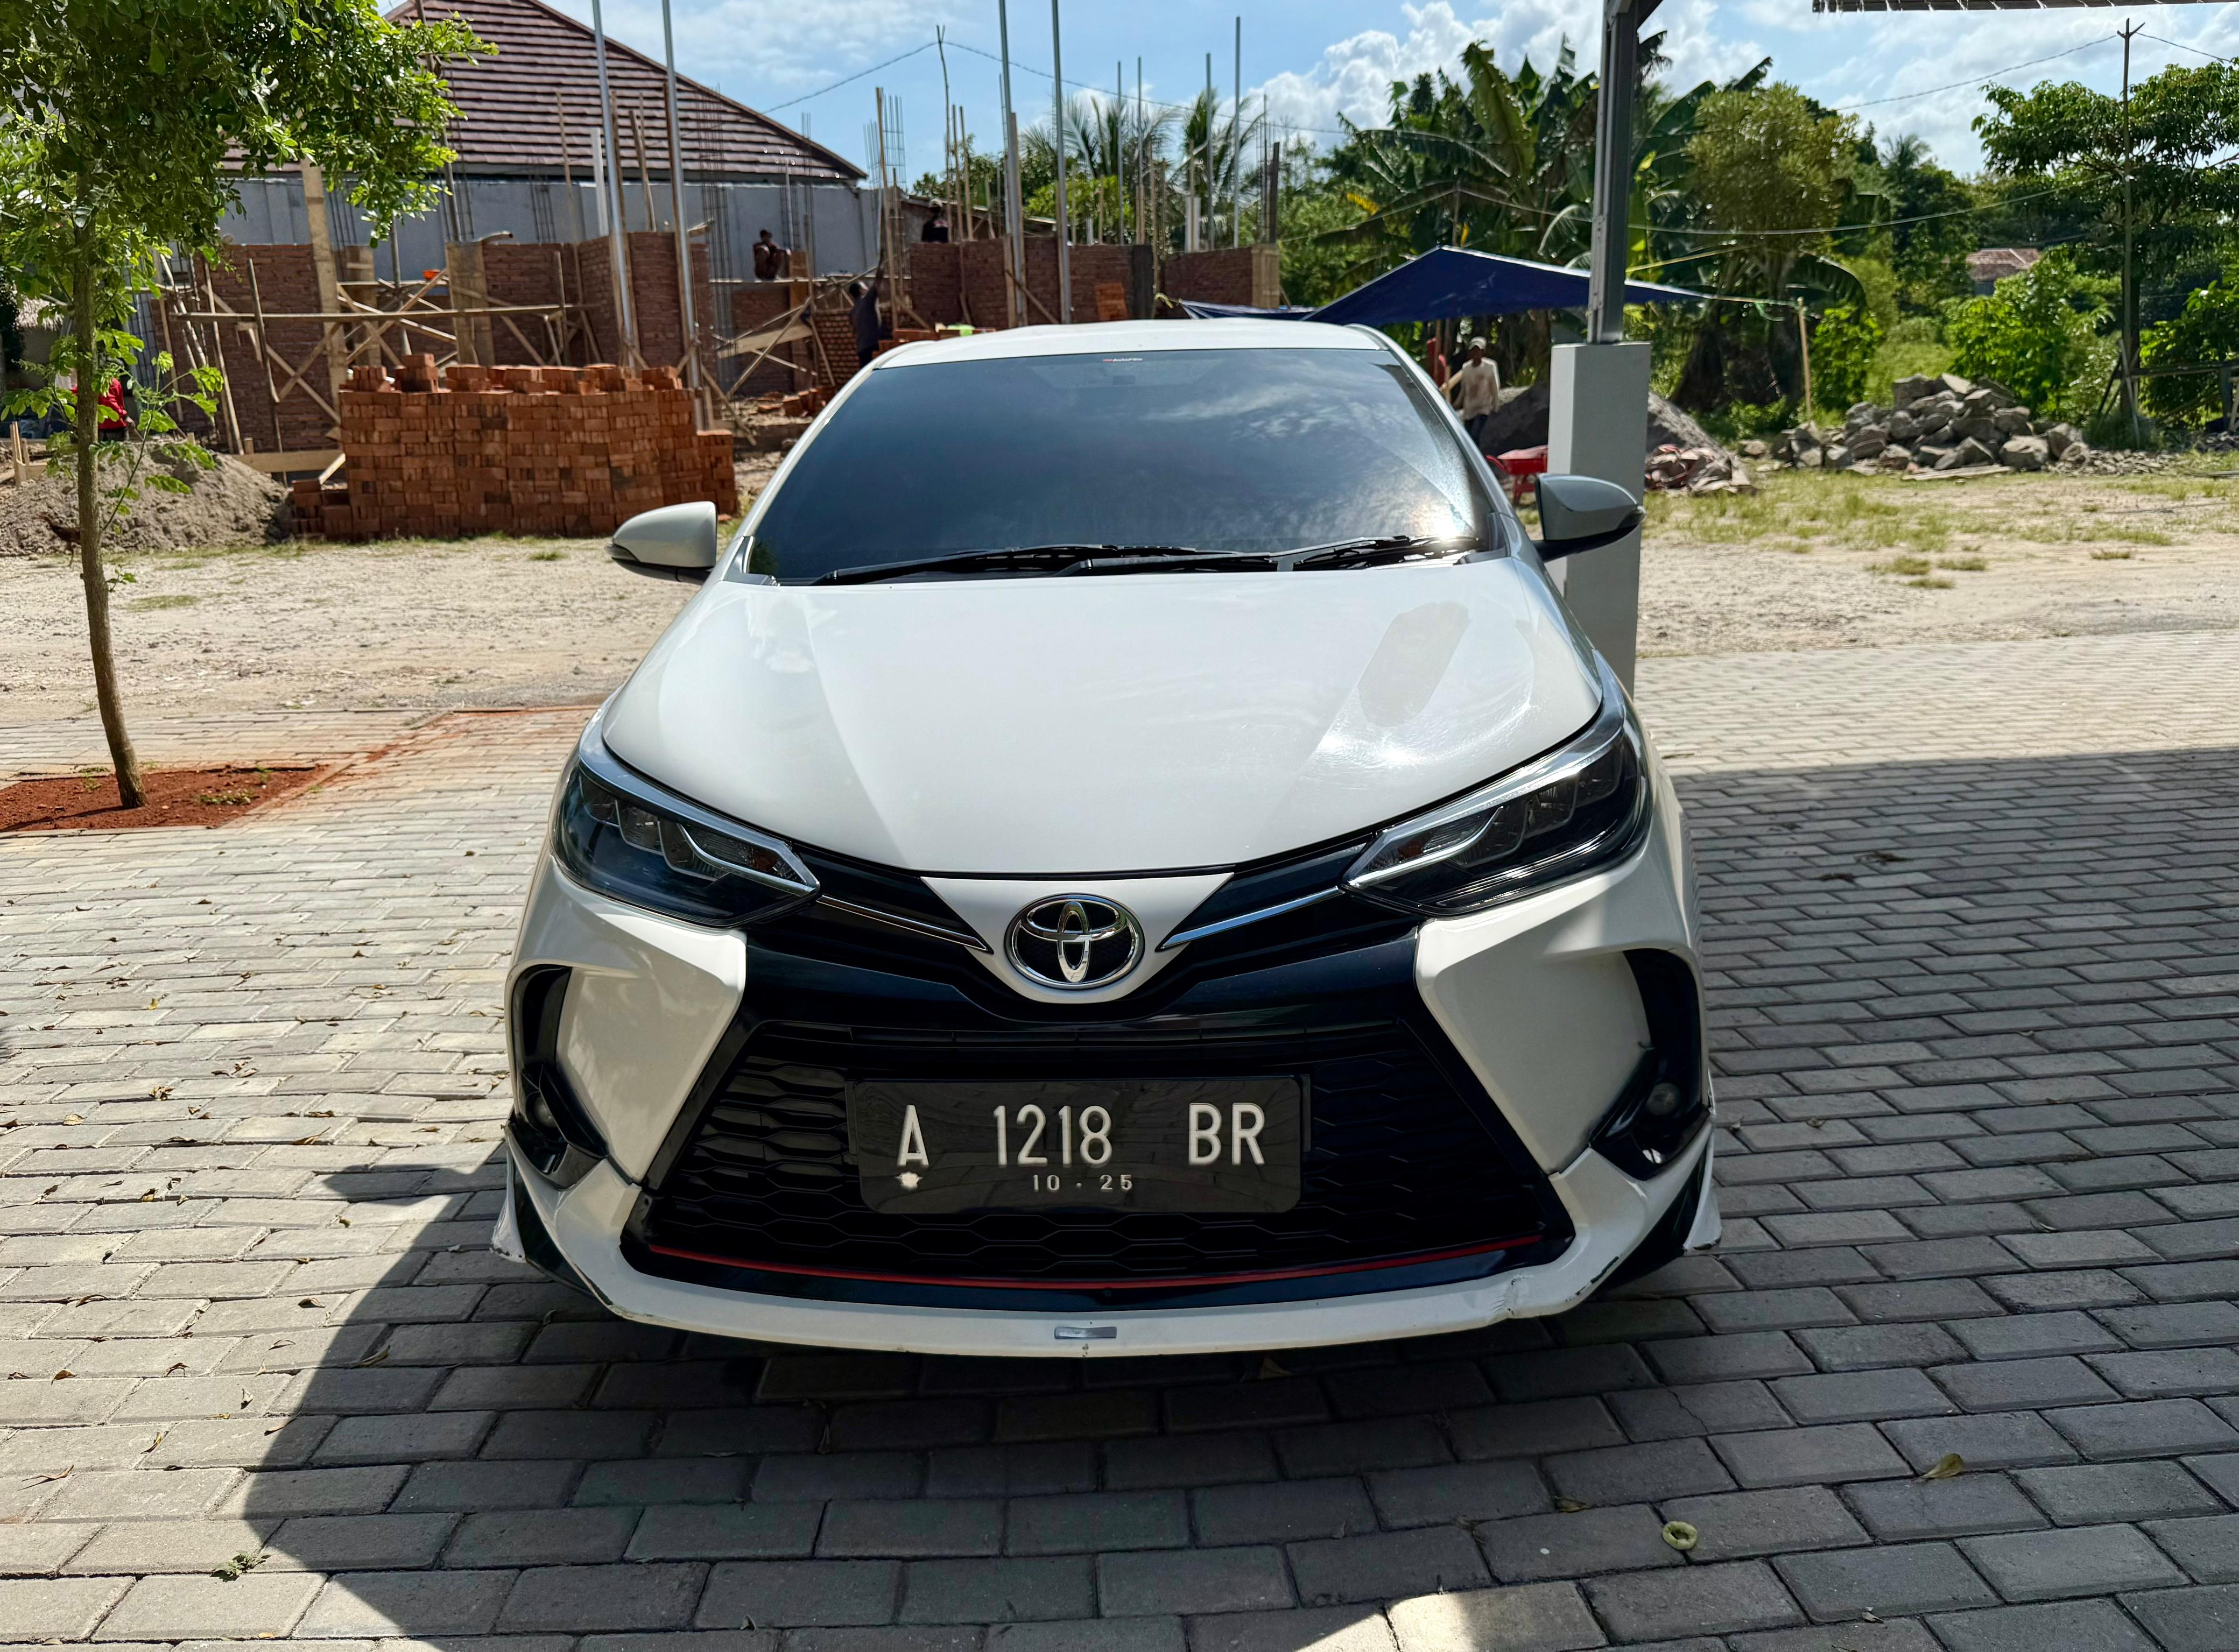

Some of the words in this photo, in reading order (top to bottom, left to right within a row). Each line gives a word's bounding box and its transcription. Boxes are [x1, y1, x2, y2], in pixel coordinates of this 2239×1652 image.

[897, 1105, 929, 1167] A
[994, 1104, 1112, 1167] 1218
[1188, 1102, 1265, 1165] BR
[1099, 1174, 1132, 1191] 25
